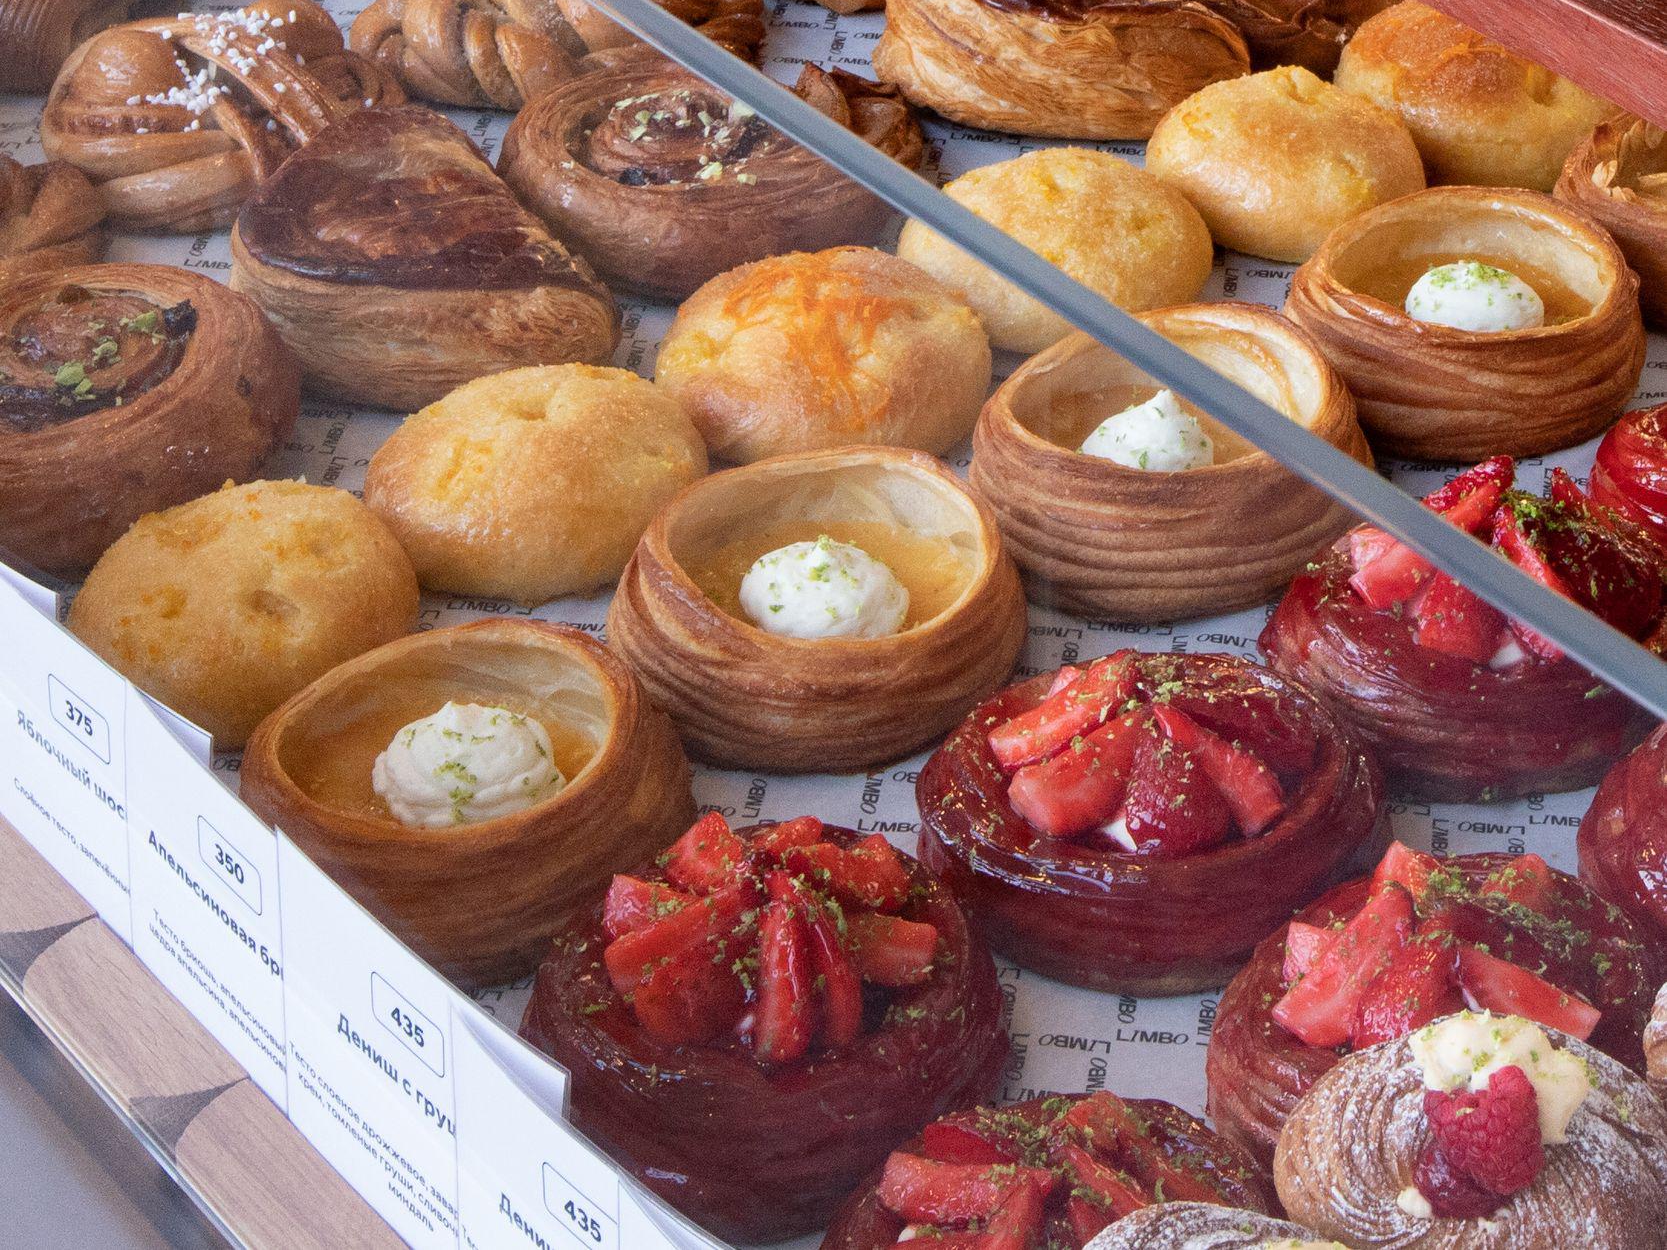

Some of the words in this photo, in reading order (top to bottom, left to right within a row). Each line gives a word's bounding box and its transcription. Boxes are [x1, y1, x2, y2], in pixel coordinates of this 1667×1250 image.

[447, 601, 511, 615] LIMBO
[65, 699, 94, 738] 375
[16, 708, 92, 791] Яблочный
[94, 782, 129, 823] шос
[741, 777, 769, 819] LIMBO
[1458, 820, 1526, 835] LIMBO
[1529, 814, 1582, 828] LIMB
[214, 842, 246, 886] 350
[148, 829, 258, 954] Апельсиновая
[152, 907, 179, 945] Тесто
[177, 953, 229, 1014] апельсина,
[390, 1006, 425, 1048] 435
[1038, 1033, 1112, 1054] LIMBO
[1116, 1028, 1190, 1046] LIMBO
[337, 1012, 399, 1084] Дениш
[402, 1077, 412, 1097] с
[289, 1039, 317, 1080] Тесто
[317, 1076, 361, 1125] слоеное
[361, 1121, 429, 1191] дрожжевое,
[297, 1071, 326, 1109] крем,
[325, 1101, 379, 1160] томленые
[378, 1154, 417, 1199] груши,
[387, 1181, 435, 1233] миндаль
[563, 1199, 603, 1244] 435
